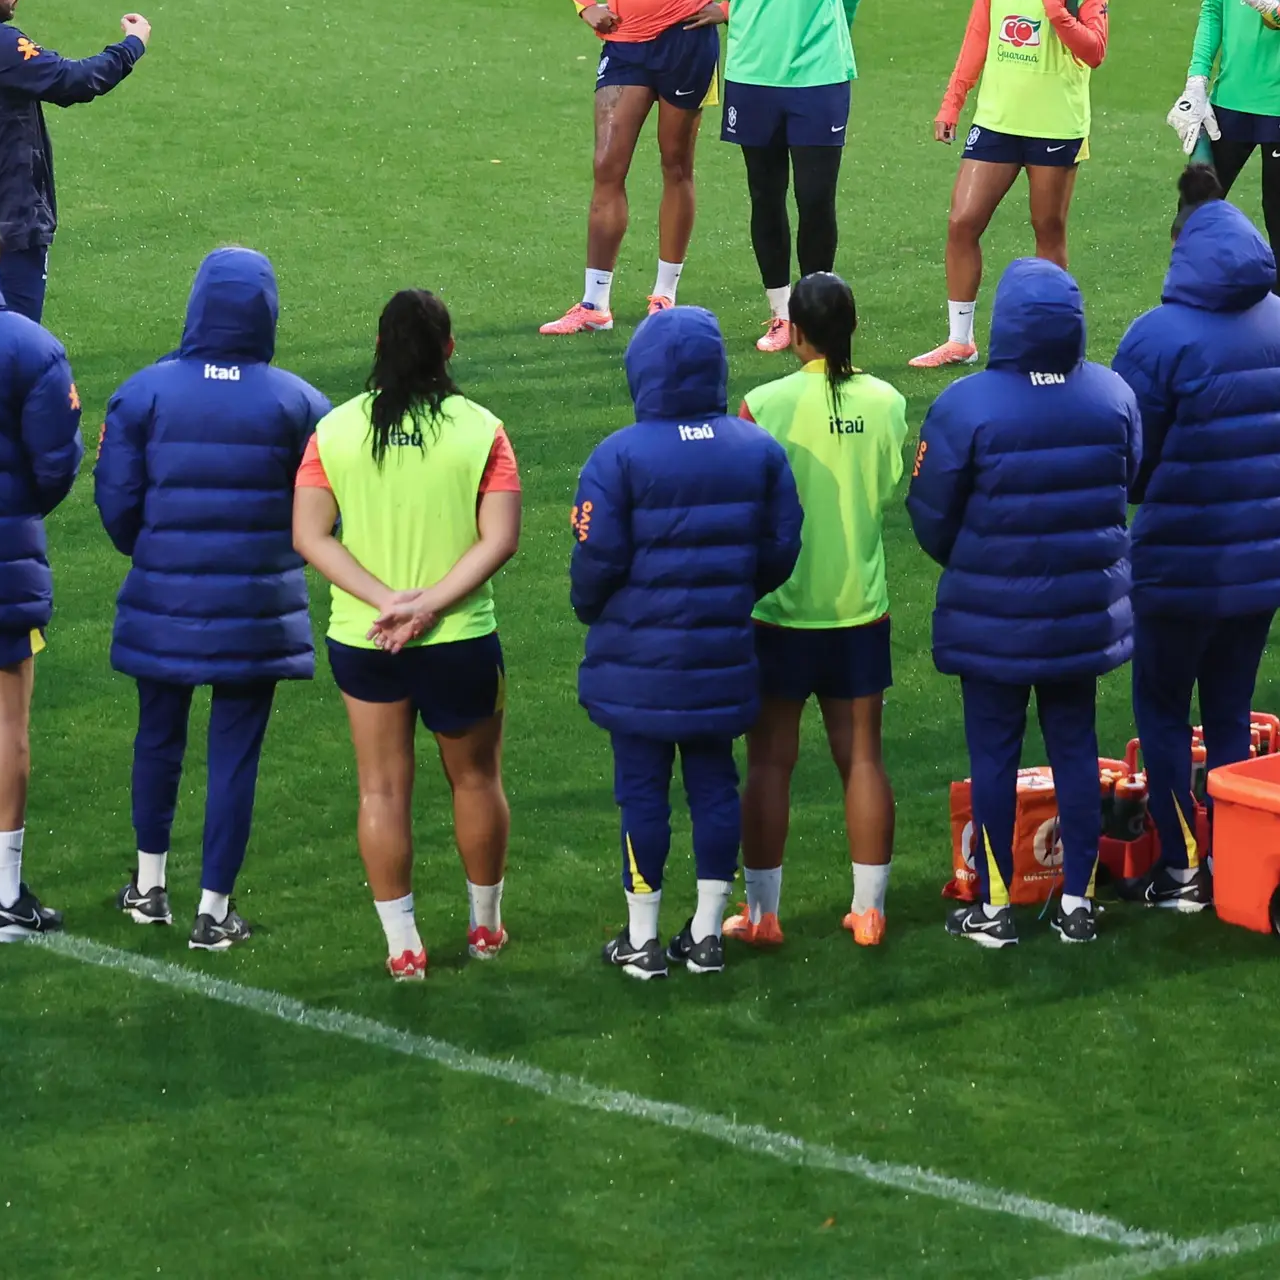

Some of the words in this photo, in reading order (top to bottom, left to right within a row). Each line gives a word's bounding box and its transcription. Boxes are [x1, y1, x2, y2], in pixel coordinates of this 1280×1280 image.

[996, 44, 1040, 63] Guaraná
[204, 363, 241, 381] itaú
[678, 423, 715, 441] itaú
[829, 416, 865, 435] itaú
[912, 441, 928, 477] vivo
[575, 501, 593, 541] vivo
